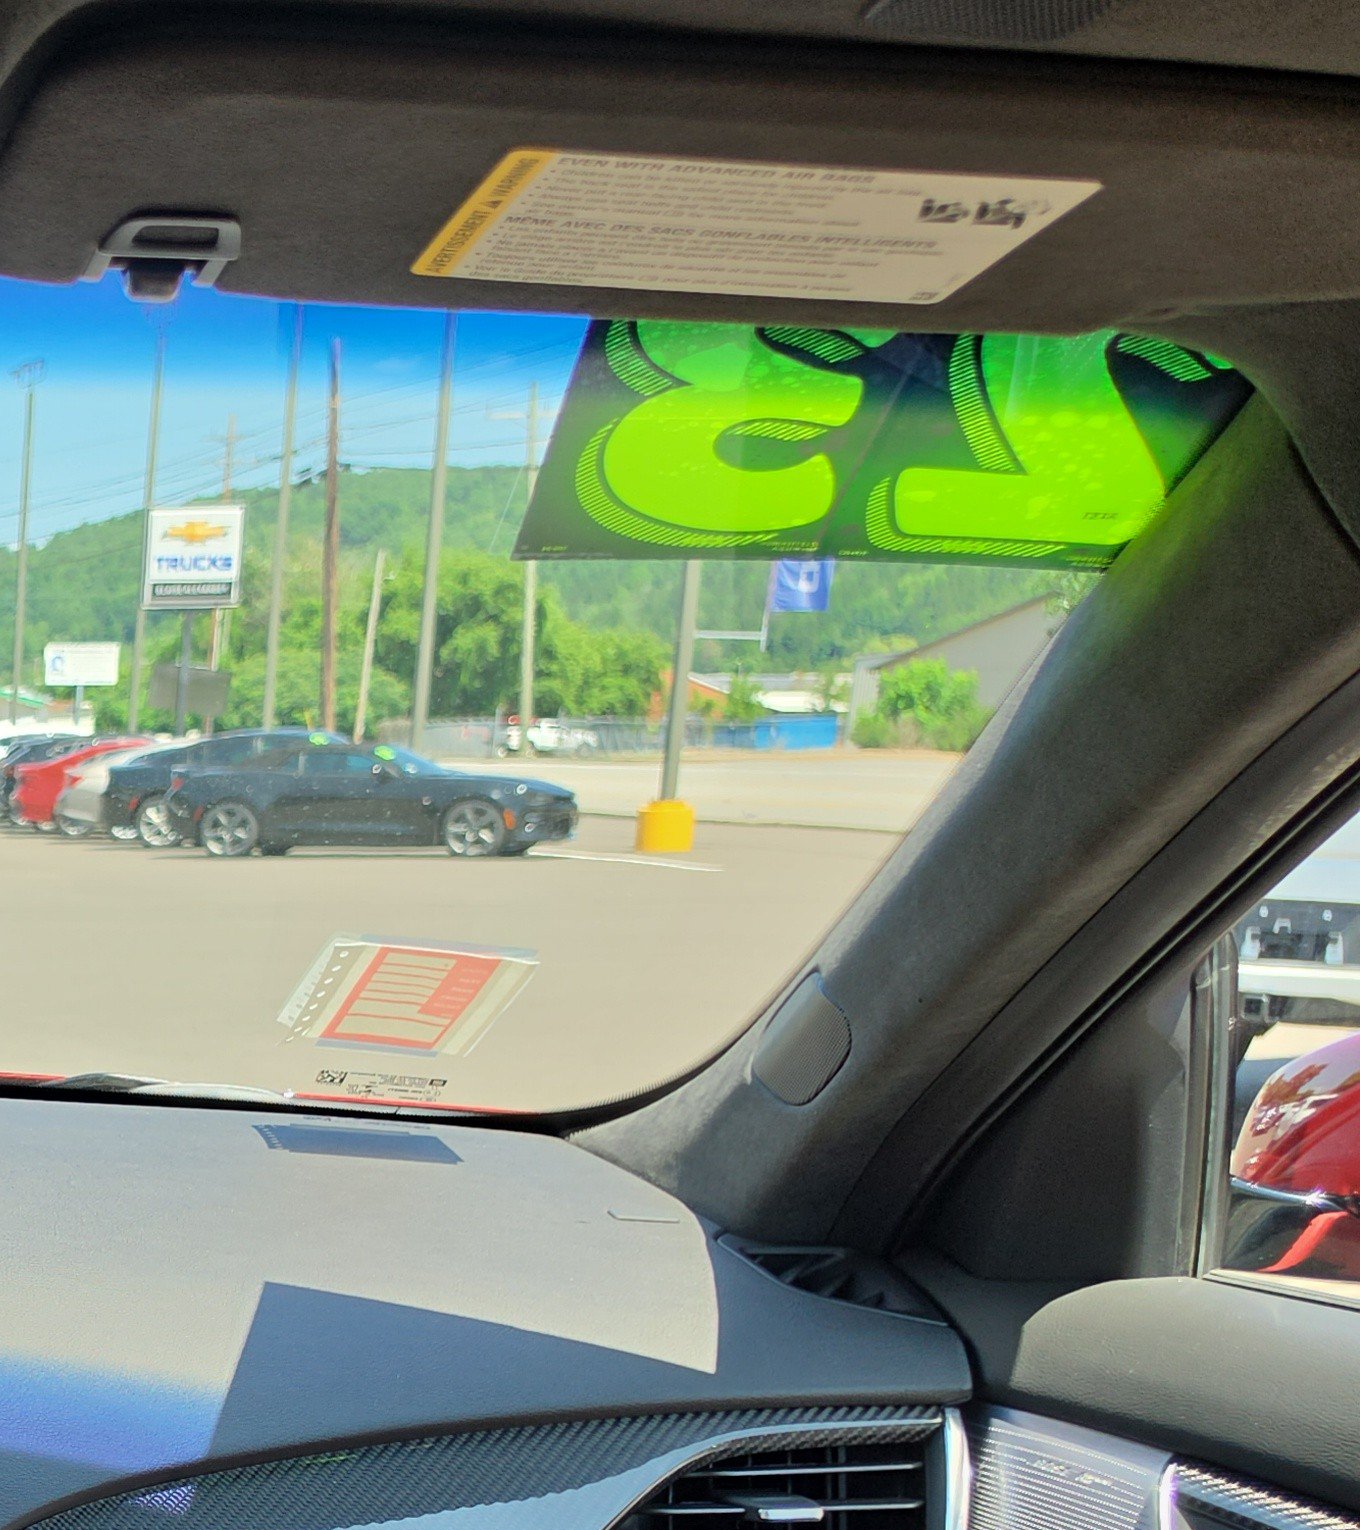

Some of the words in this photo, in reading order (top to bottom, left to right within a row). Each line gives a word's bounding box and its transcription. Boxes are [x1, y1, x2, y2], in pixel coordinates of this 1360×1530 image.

[557, 157, 609, 167] EVEN
[615, 161, 665, 171] WITH
[668, 163, 777, 177] ADVANCED
[781, 170, 817, 180] AIR
[820, 173, 877, 184] BAGS
[425, 210, 493, 273] AVERTISSEMENT
[561, 220, 607, 230] AVEC
[610, 223, 646, 233] DES
[648, 225, 697, 236] SACS
[699, 228, 813, 242] GONFLABLES
[815, 235, 938, 249] INTELLIGENTS
[156, 556, 233, 572] TRUCKS
